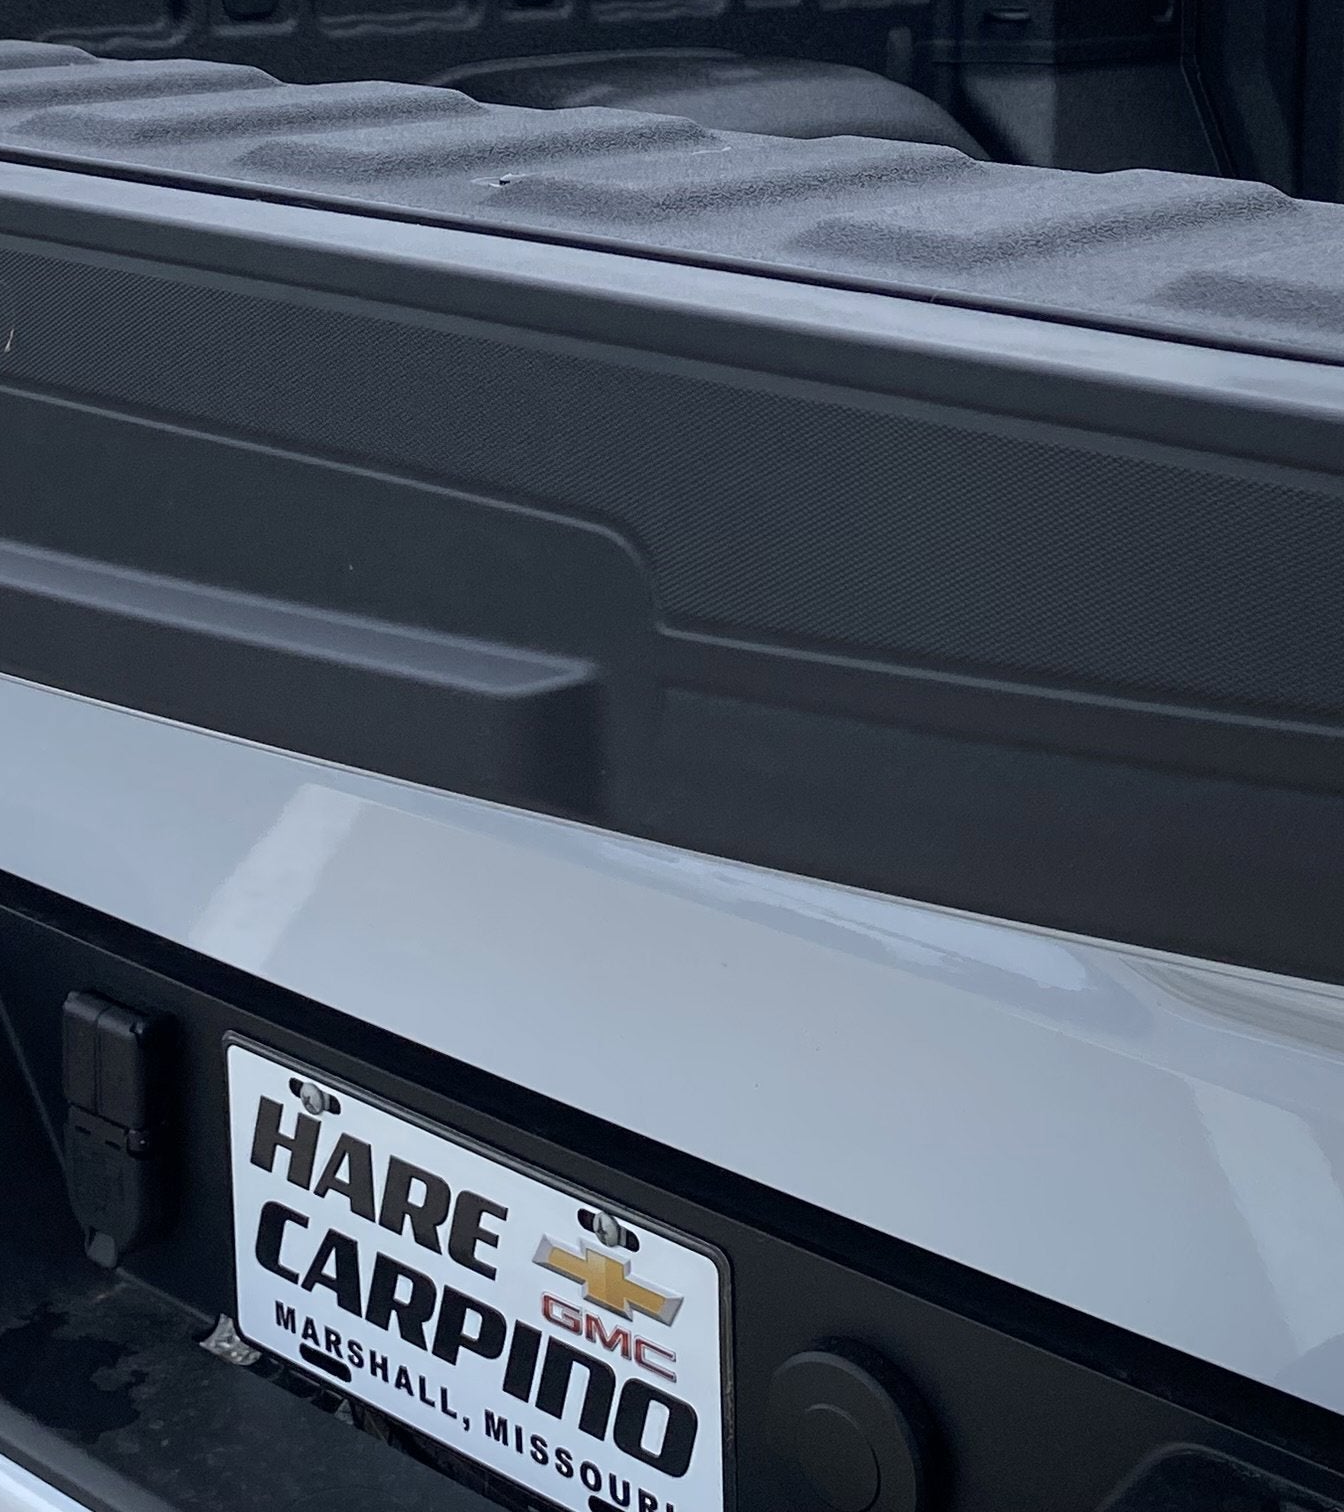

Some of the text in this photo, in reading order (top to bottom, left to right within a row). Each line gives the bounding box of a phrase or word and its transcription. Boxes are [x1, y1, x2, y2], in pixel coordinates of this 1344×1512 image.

[250, 1094, 509, 1281] HARE
[254, 1200, 700, 1478] CARPINO
[274, 1300, 473, 1432] MARSHALL,
[541, 1290, 678, 1384] GMC
